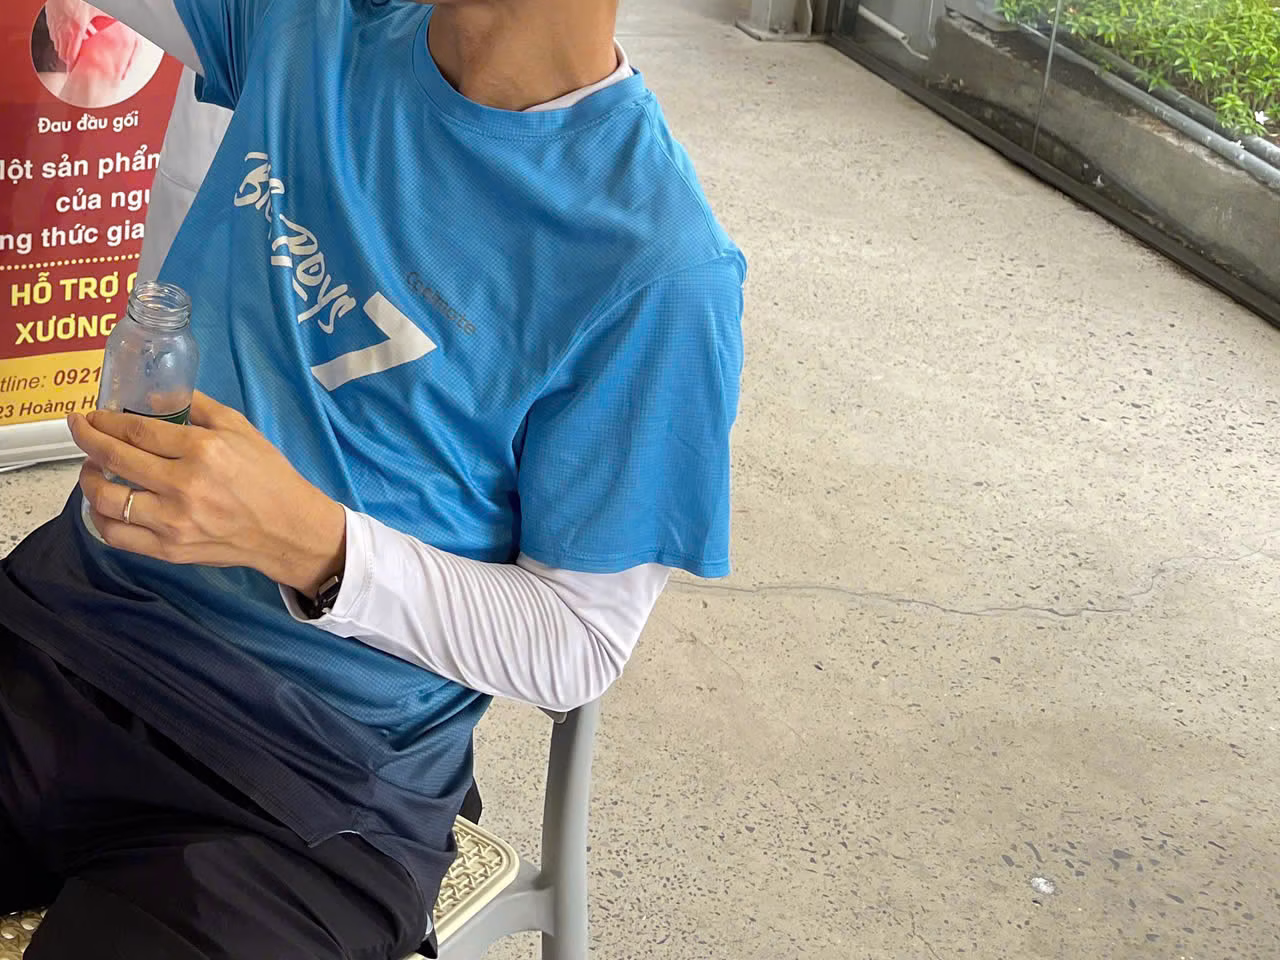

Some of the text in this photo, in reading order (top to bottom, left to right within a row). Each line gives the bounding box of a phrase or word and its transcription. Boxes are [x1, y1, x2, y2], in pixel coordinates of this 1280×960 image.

[37, 111, 139, 133] Đau đầu gối
[42, 153, 89, 179] sản
[56, 189, 102, 212] của
[41, 226, 98, 249] thức
[107, 220, 144, 246] gia
[11, 271, 53, 306] HỖ
[59, 274, 119, 301] TRỢ
[15, 313, 116, 344] XƯƠNG
[19, 400, 76, 416] Hoàng
